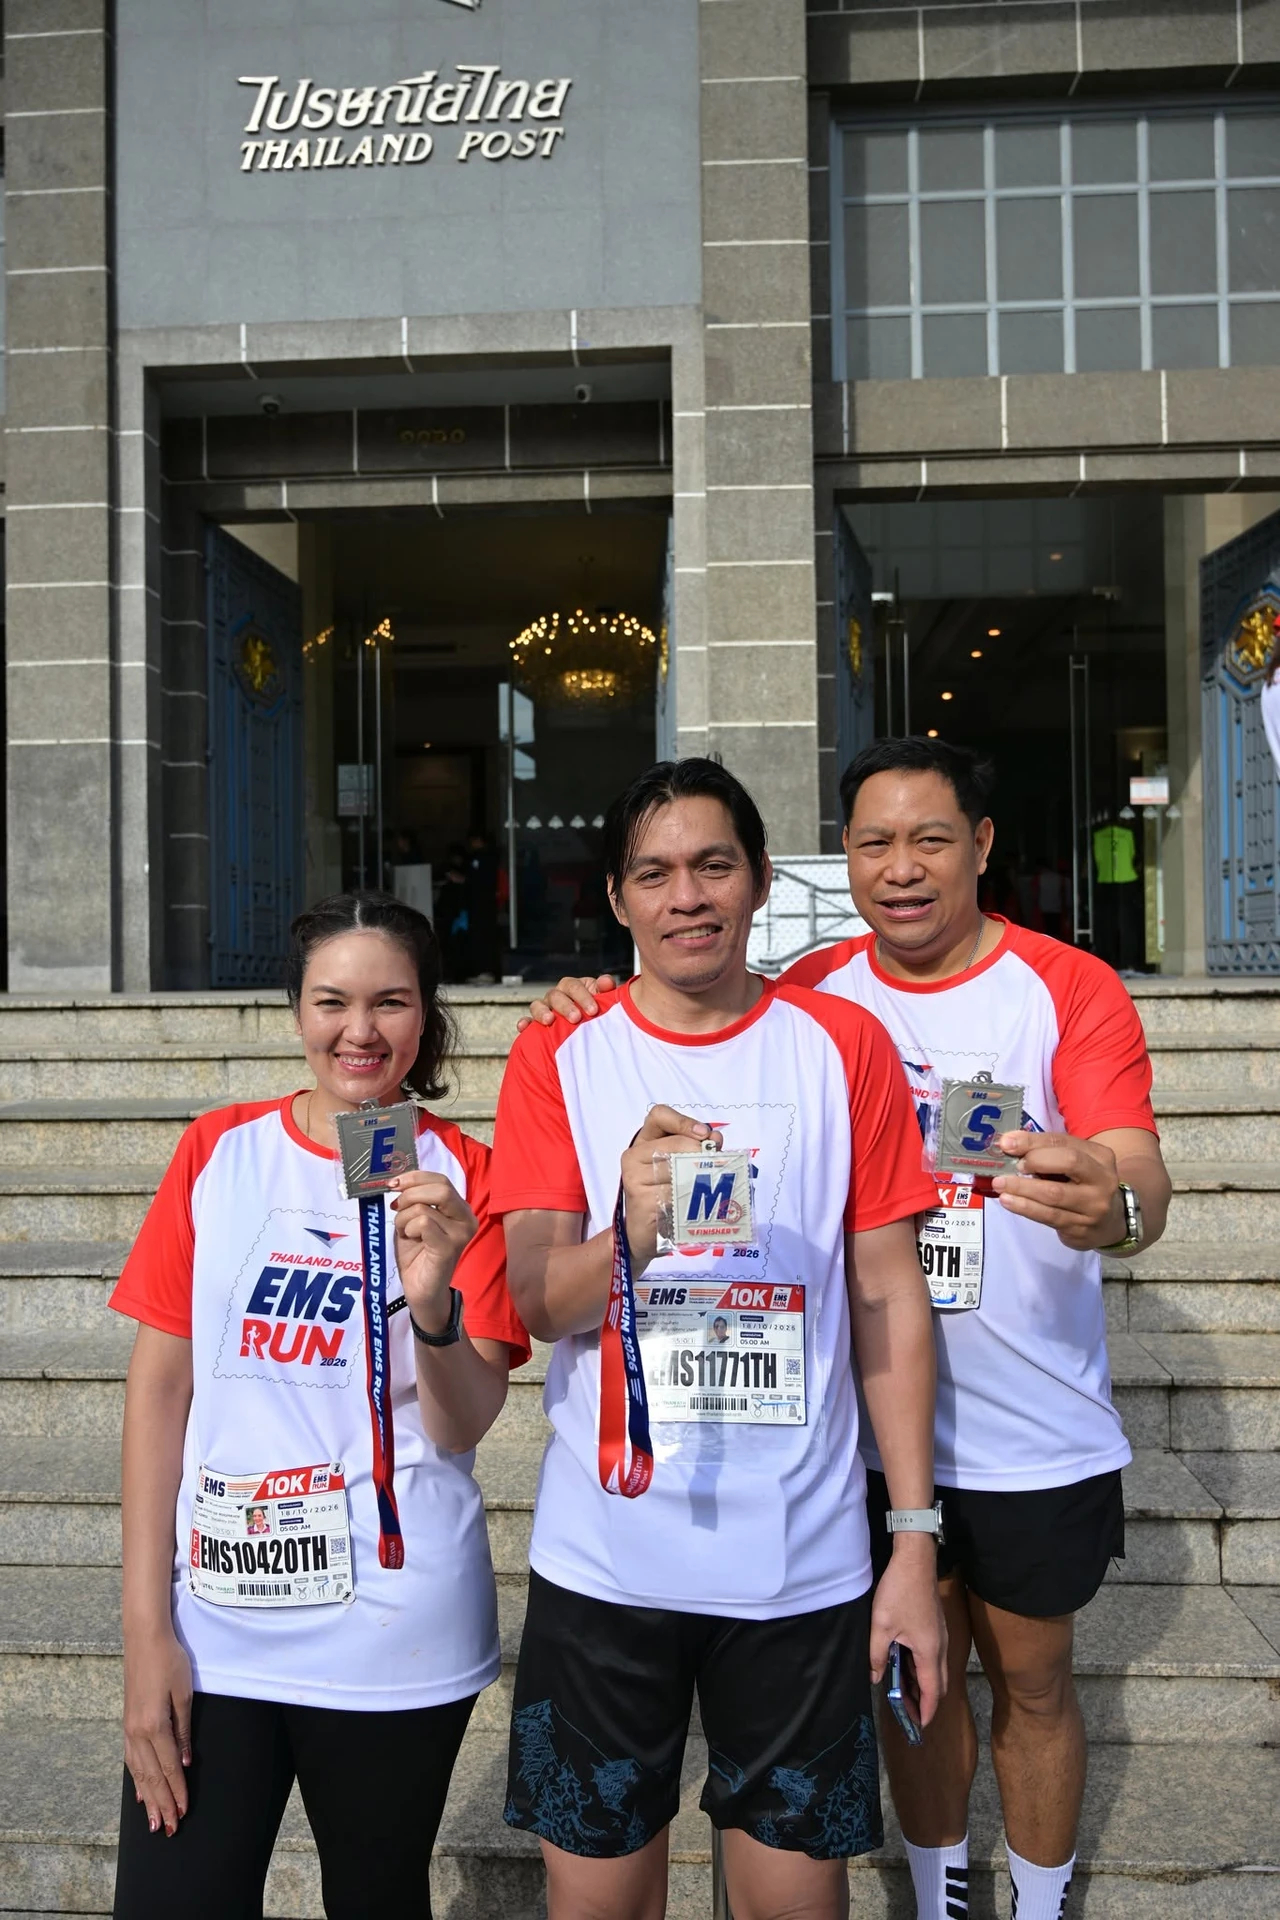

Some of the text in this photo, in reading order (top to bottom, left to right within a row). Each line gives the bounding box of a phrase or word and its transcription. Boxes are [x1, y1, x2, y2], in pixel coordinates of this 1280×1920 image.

[237, 65, 572, 132] ไปรษณีย์ไทย
[240, 126, 565, 170] THAILAND POST
[971, 1092, 988, 1100] EMS
[364, 1118, 378, 1127] EMS
[961, 1104, 1002, 1151] S
[370, 1127, 397, 1174] E
[699, 1161, 714, 1169] EMS
[686, 1173, 737, 1221] M
[367, 1203, 380, 1288] THAILAND
[695, 1228, 732, 1236] FINISHER
[269, 1252, 364, 1272] THAILAND POS
[732, 1248, 760, 1258] 2026
[245, 1266, 364, 1324] EMS
[649, 1288, 687, 1306] EMS
[730, 1288, 767, 1307] 10K
[773, 1294, 788, 1302] EMS
[370, 1290, 383, 1334] POST
[239, 1318, 345, 1366] RUN
[373, 1337, 383, 1374] EMS
[621, 1336, 638, 1372] 2026
[319, 1357, 347, 1367] 2026
[649, 1350, 777, 1389] EMS11771TH
[373, 1375, 383, 1412] RUN
[204, 1476, 226, 1498] EMS
[266, 1473, 306, 1496] 10K
[313, 1473, 328, 1484] EMS
[192, 1554, 199, 1565] 4
[201, 1535, 328, 1575] EMS10420TH
